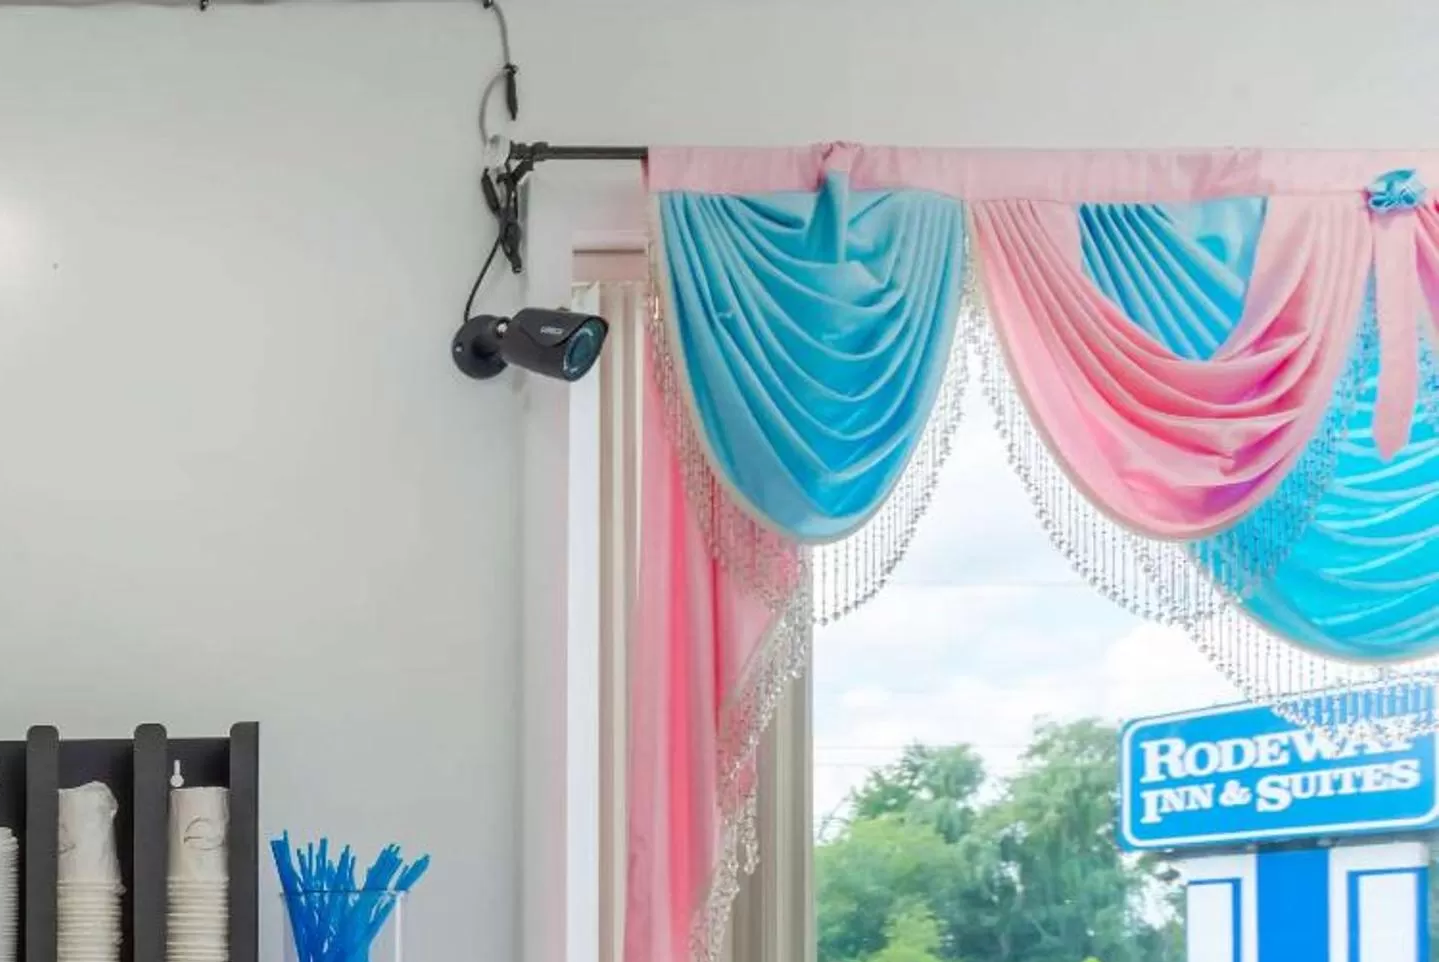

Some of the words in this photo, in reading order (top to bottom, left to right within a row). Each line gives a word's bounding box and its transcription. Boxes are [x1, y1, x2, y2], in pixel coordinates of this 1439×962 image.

[1140, 783, 1216, 824] INN
[1219, 779, 1252, 806] &
[1256, 758, 1421, 812] SUITES
